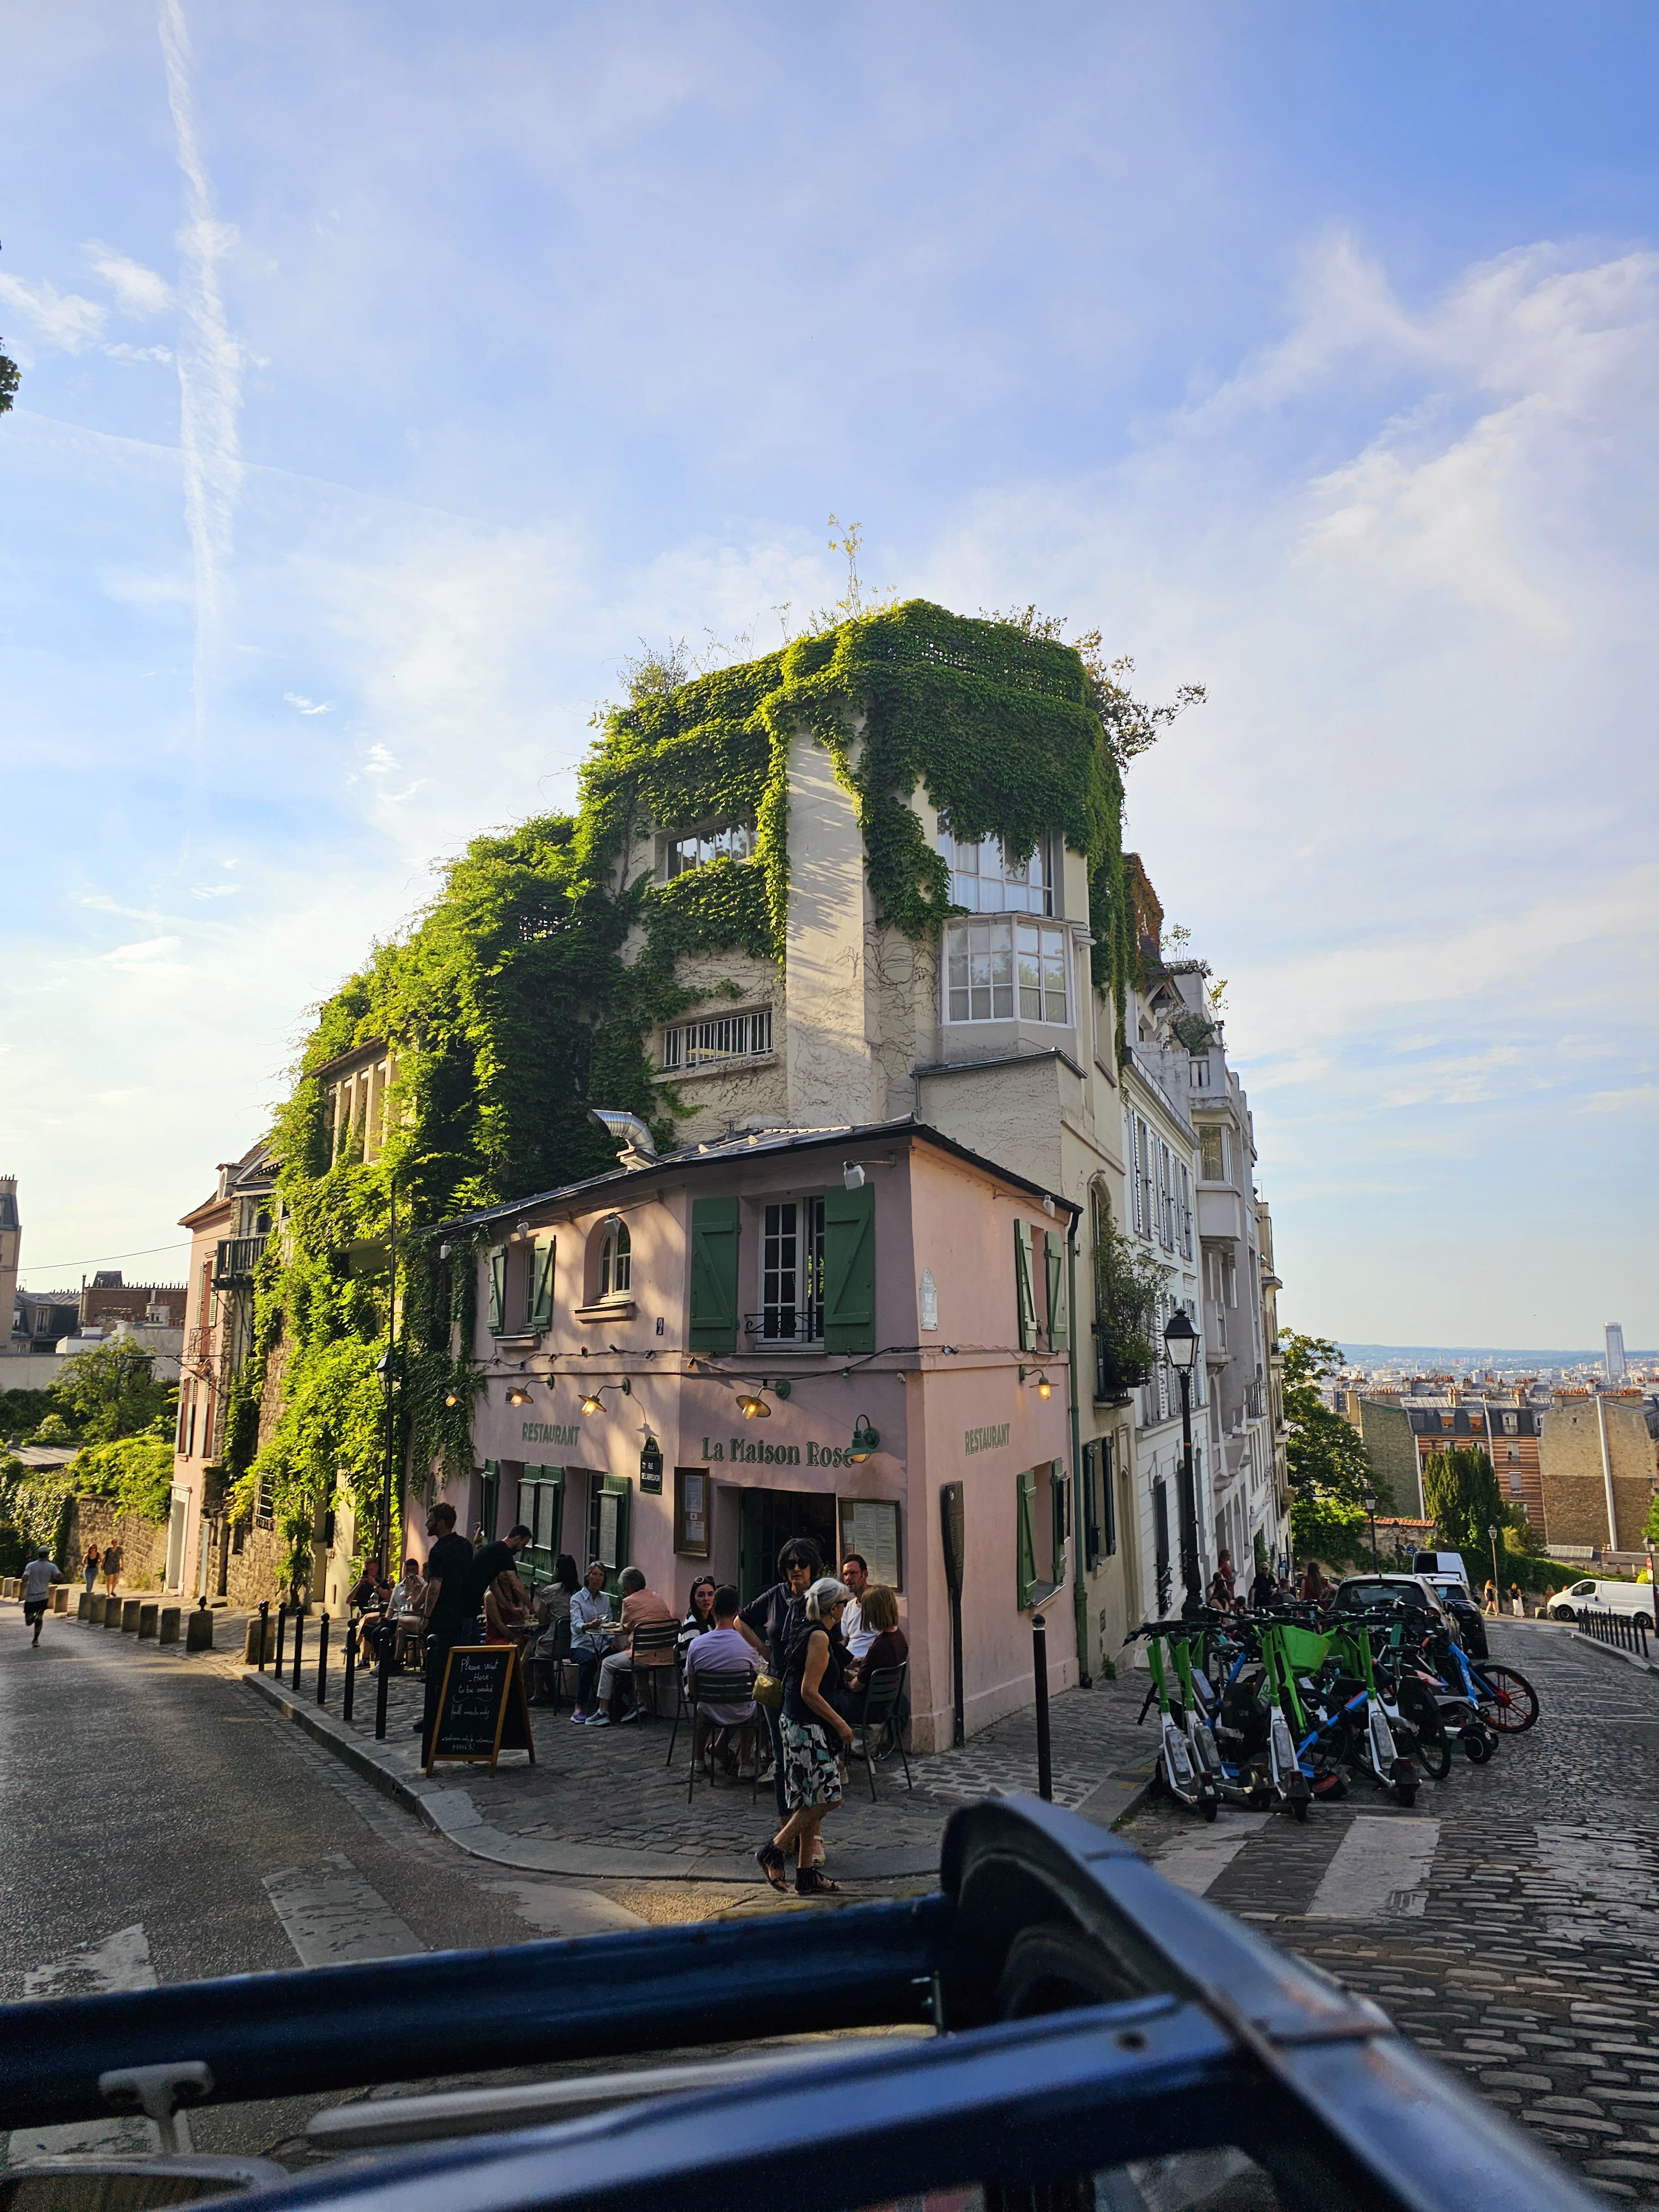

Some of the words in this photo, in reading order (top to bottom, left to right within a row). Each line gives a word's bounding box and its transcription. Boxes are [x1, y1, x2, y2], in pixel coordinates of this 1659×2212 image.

[658, 1318, 662, 1334] 2
[521, 1422, 580, 1447] RESTAURANT
[964, 1423, 1010, 1455] RESTAURANT
[701, 1437, 724, 1462] La
[729, 1438, 800, 1465] Maison
[461, 1656, 481, 1672] Please
[458, 1684, 465, 1693] to
